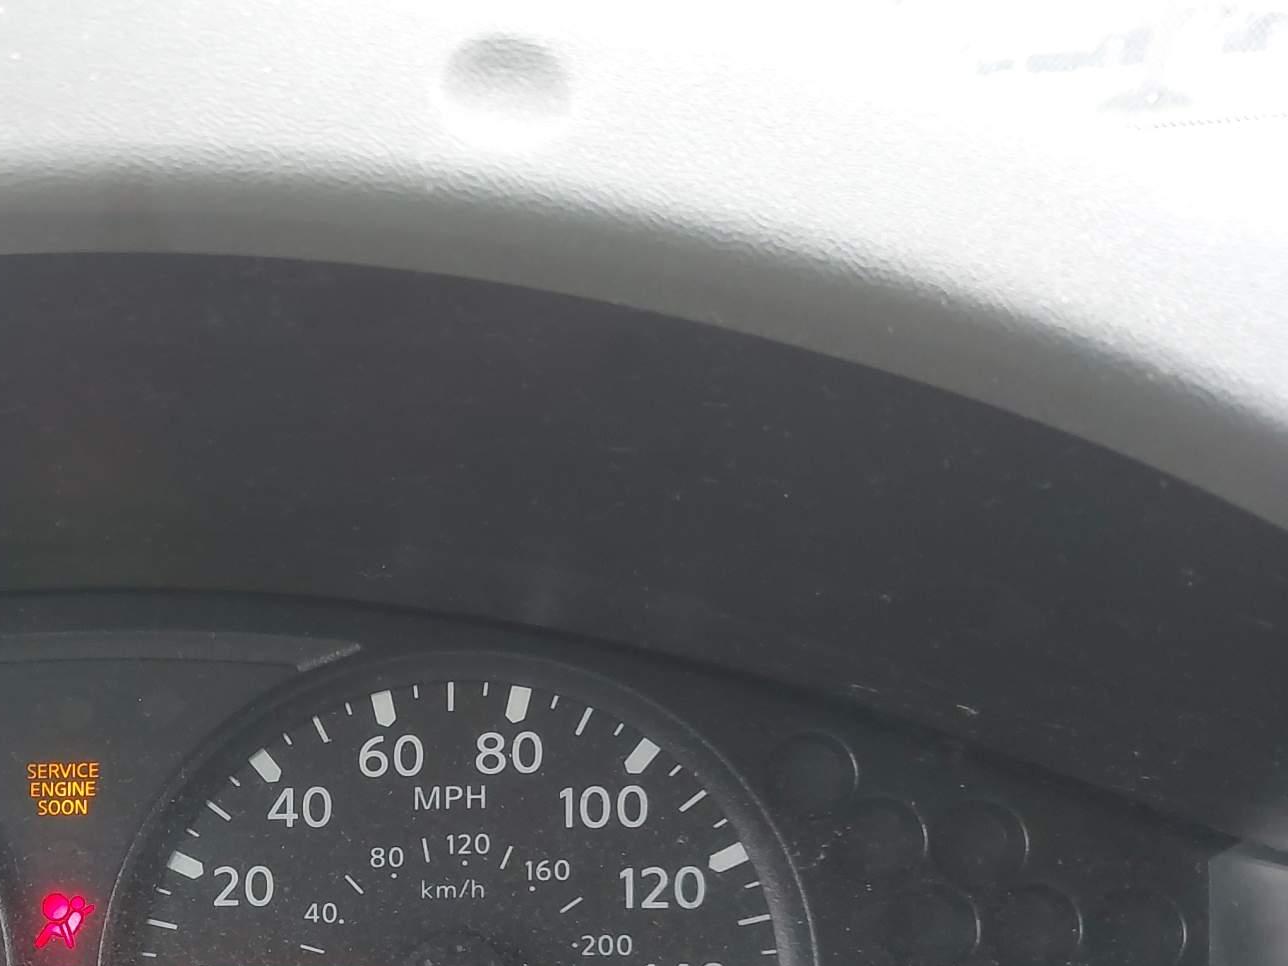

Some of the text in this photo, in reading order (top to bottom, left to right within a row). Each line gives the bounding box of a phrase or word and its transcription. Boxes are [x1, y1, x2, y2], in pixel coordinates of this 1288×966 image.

[358, 734, 424, 778] 60
[475, 731, 543, 775] 80
[27, 762, 99, 779] SERVICE
[30, 781, 96, 797] ENGINE
[414, 785, 486, 811] MPH
[38, 799, 88, 816] SOON
[267, 786, 332, 828] 40
[559, 785, 648, 829] 100
[446, 833, 490, 855] 120
[370, 846, 404, 868] 80
[525, 859, 570, 881] 160
[213, 865, 274, 907] 20
[421, 879, 485, 899] km/h
[619, 866, 706, 909] 120
[581, 934, 633, 956] 200
